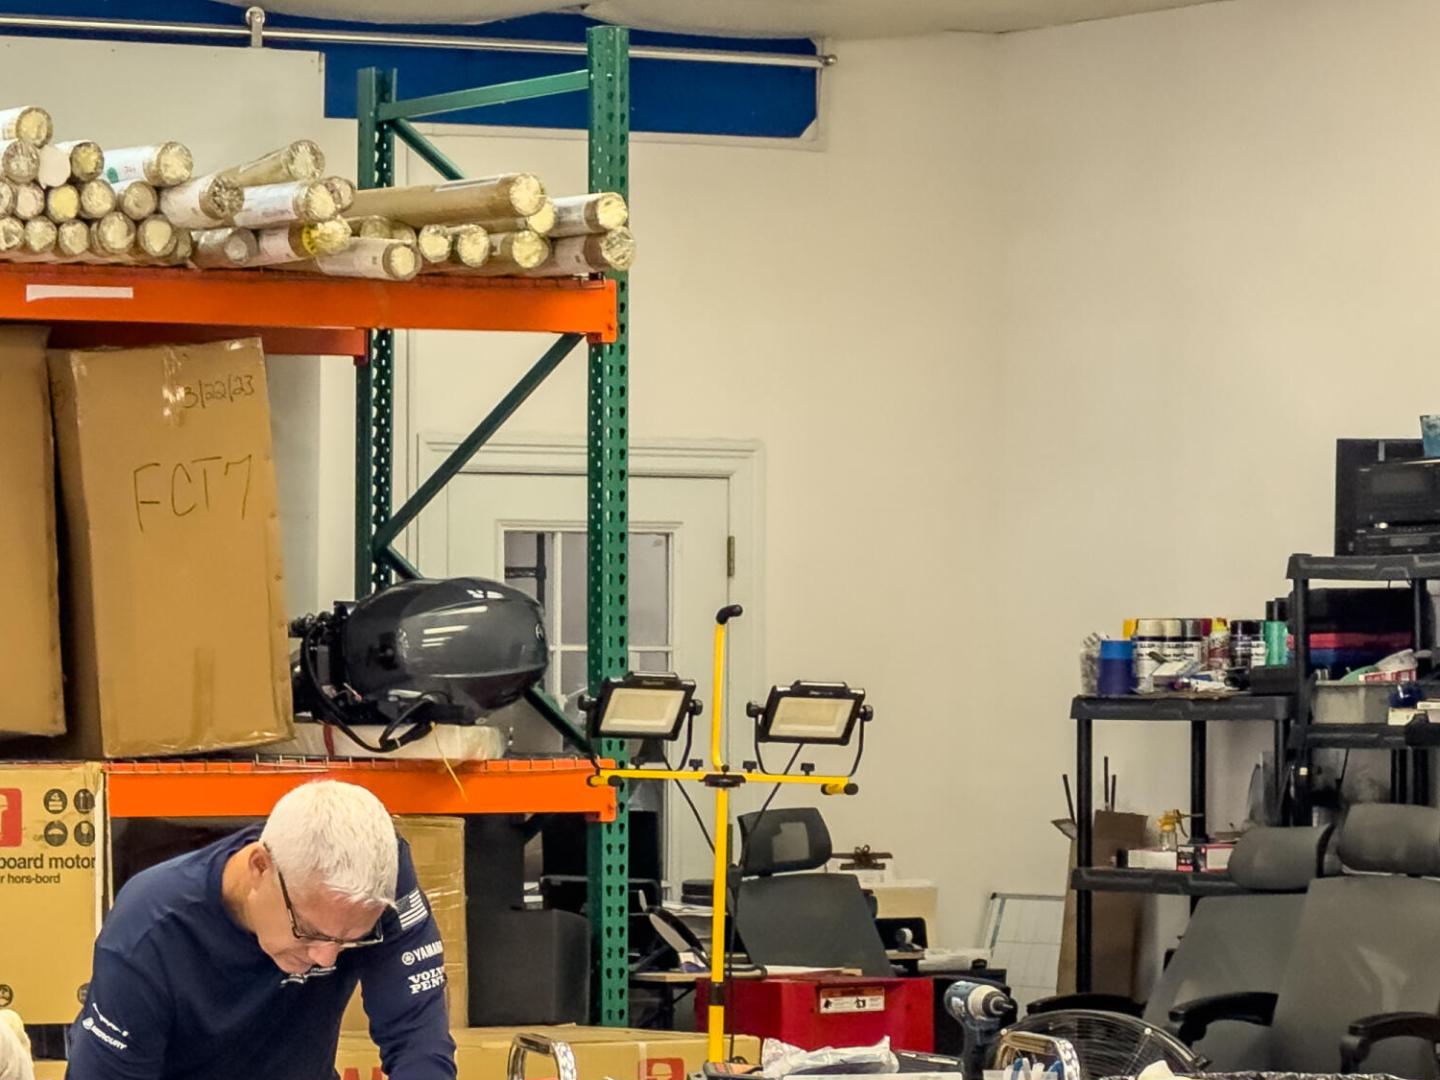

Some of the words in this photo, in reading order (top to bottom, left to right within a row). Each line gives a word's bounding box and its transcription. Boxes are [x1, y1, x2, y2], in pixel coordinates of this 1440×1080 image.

[183, 374, 255, 409] 3/22/23
[49, 855, 96, 870] motor
[8, 873, 61, 885] hors-bord
